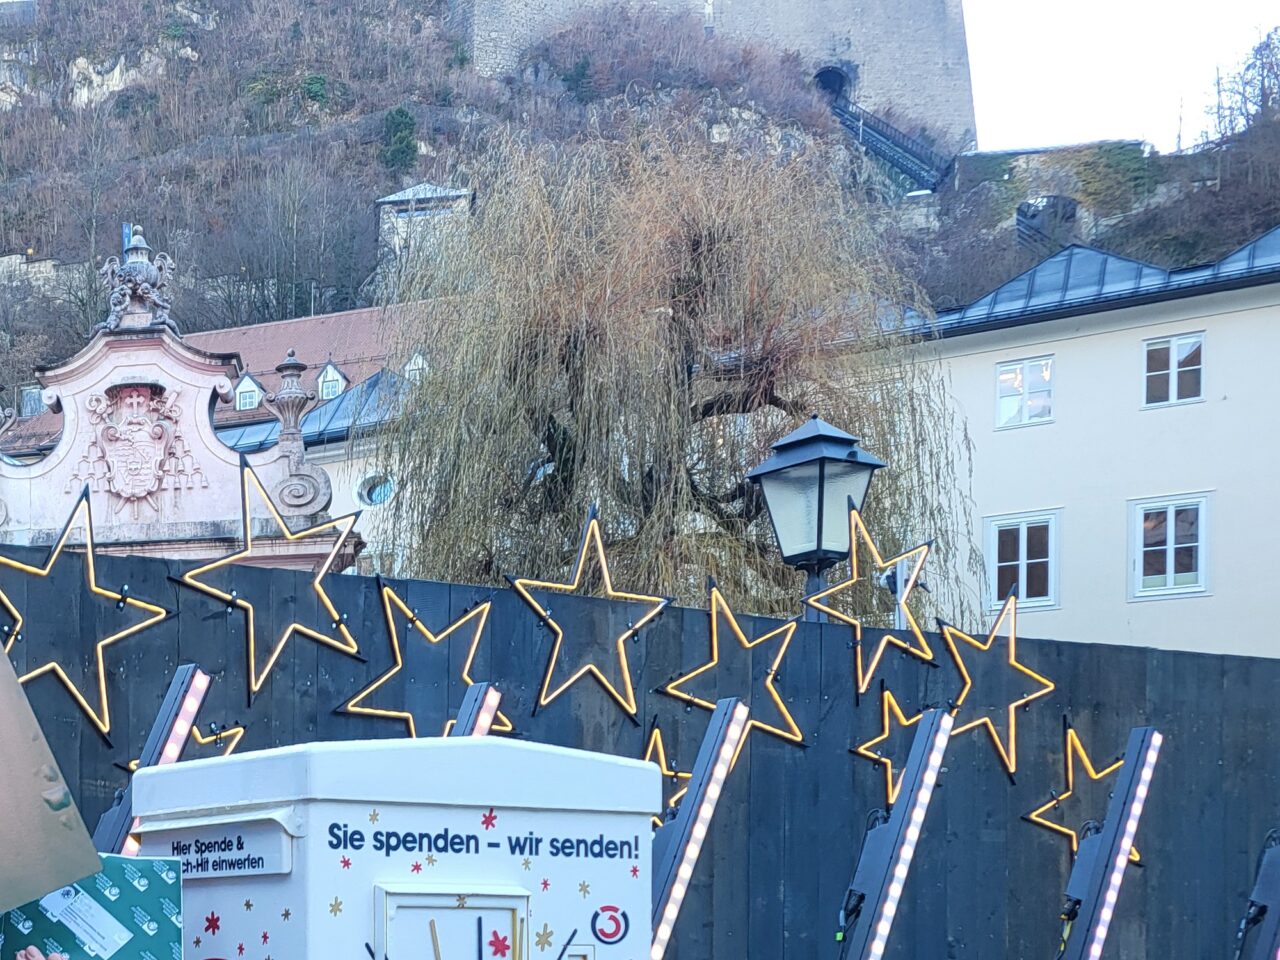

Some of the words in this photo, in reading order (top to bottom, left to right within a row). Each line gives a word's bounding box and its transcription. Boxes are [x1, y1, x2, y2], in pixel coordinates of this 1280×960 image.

[172, 840, 192, 856] Hier
[194, 837, 233, 856] Spende
[236, 835, 244, 850] &
[328, 822, 365, 851] Sie
[373, 828, 480, 856] spenden
[508, 832, 543, 856] wir
[549, 834, 640, 860] senden!
[212, 854, 264, 872] einwerfen
